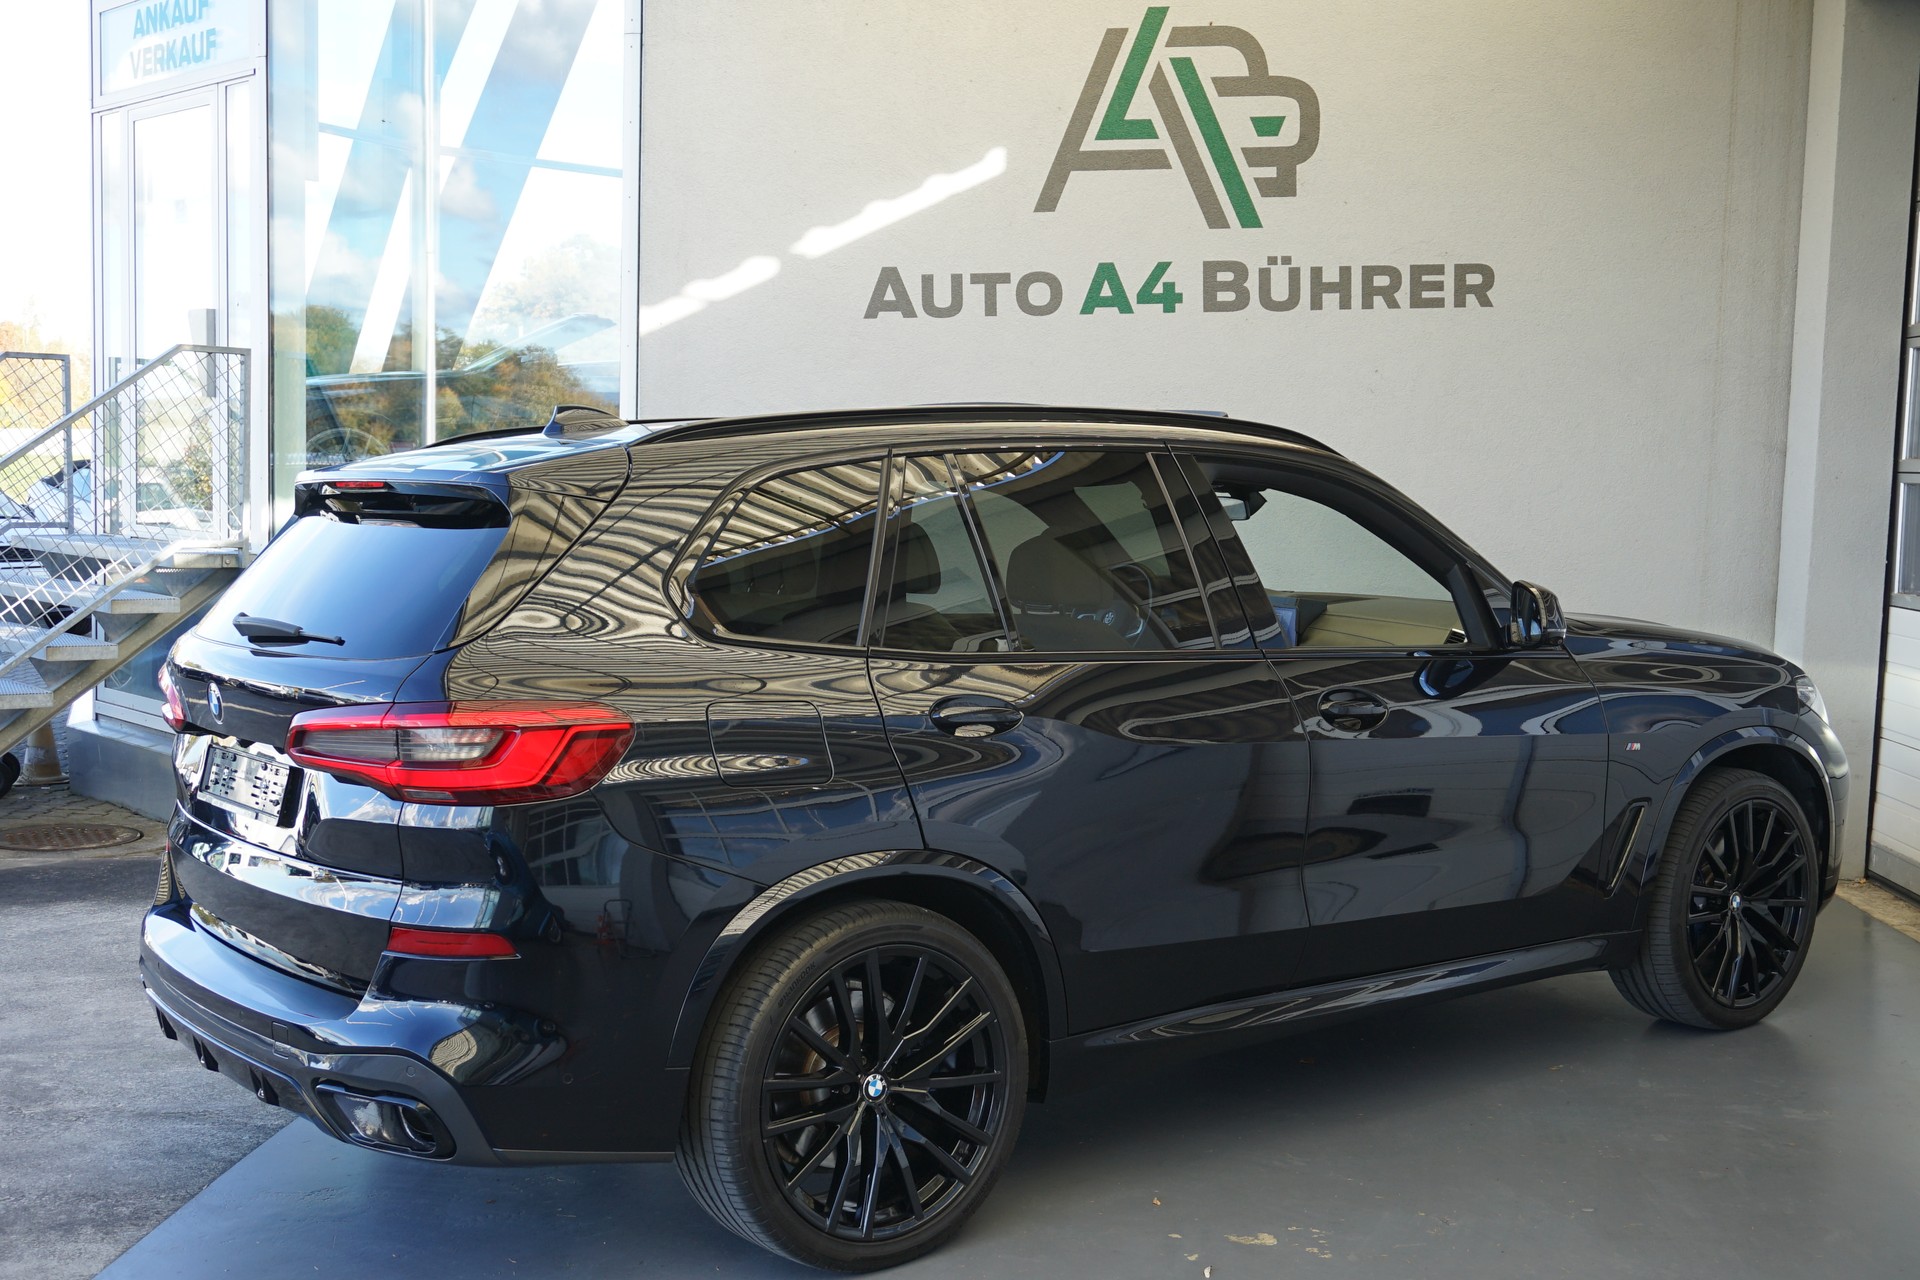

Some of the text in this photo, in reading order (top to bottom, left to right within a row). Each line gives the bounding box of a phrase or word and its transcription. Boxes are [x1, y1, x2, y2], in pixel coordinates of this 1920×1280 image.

[132, 0, 209, 39] ANKAUF
[130, 27, 217, 79] VERKAUF
[1079, 261, 1184, 315] A4
